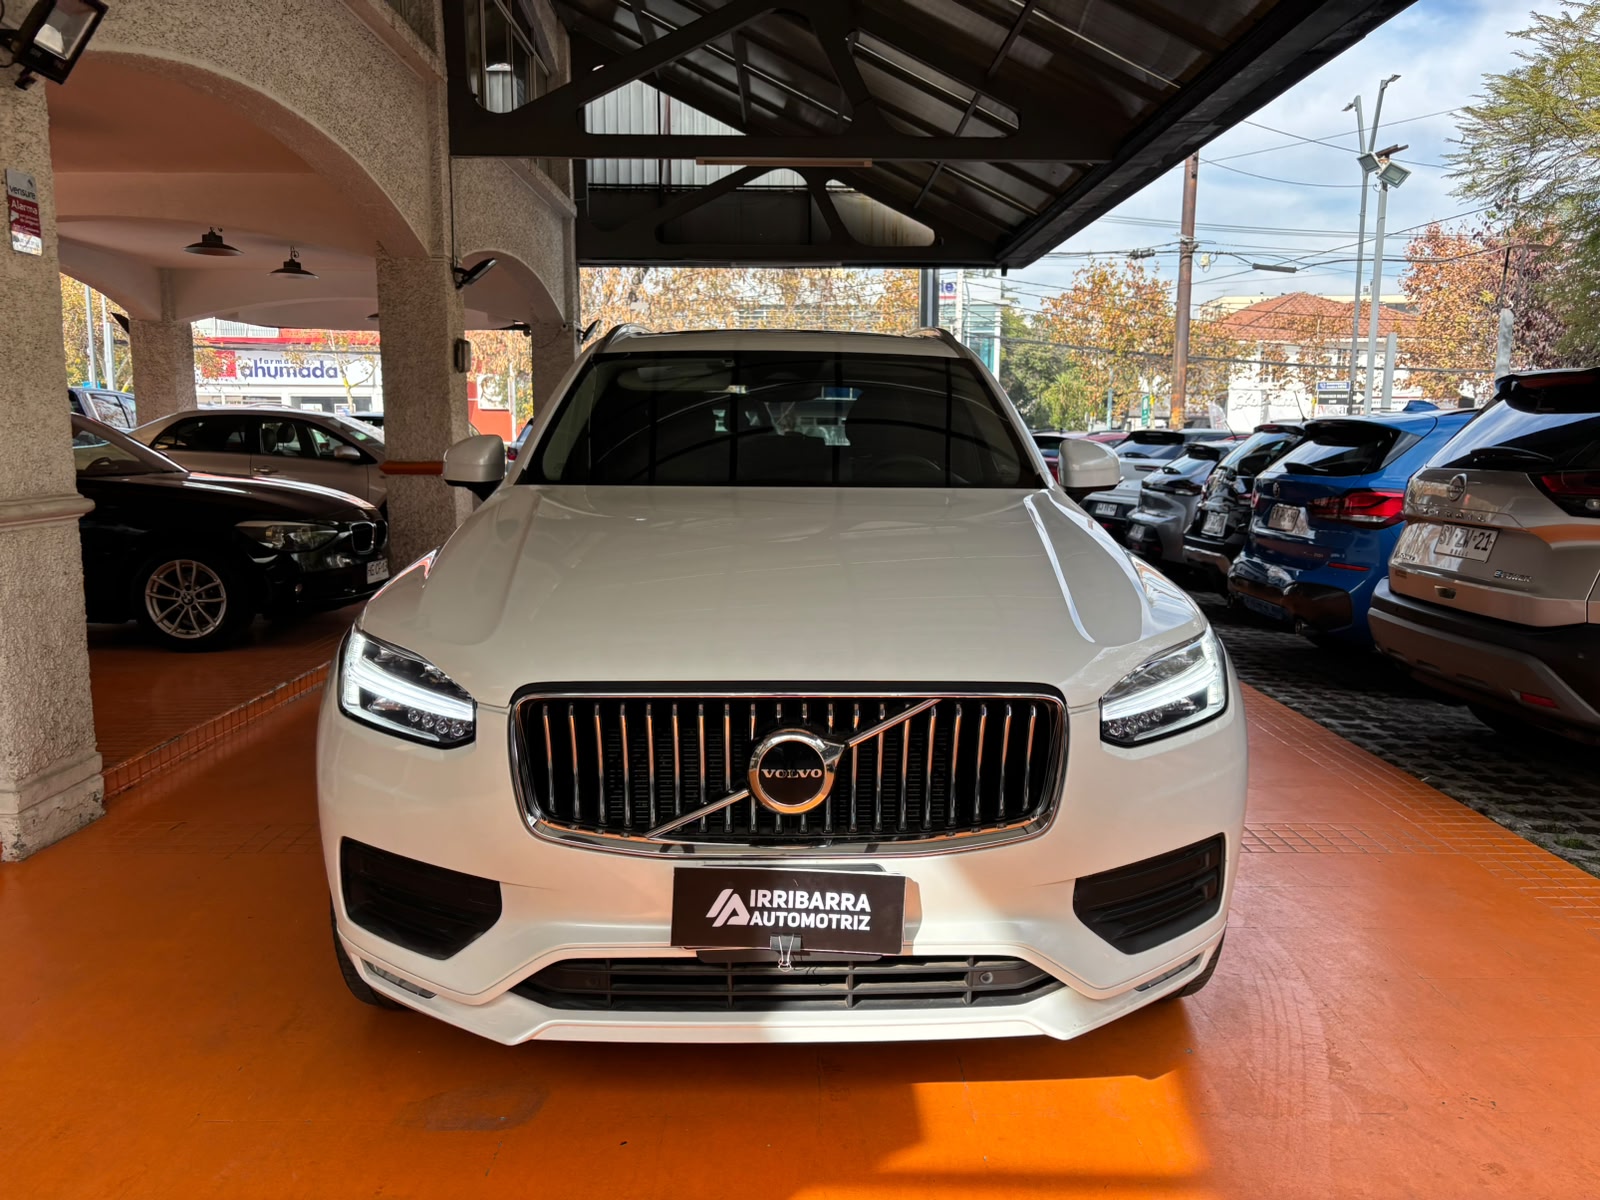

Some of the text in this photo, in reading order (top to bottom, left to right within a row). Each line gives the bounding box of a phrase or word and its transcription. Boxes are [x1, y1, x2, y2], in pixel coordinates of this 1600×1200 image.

[11, 200, 38, 214] Alarma
[241, 359, 338, 379] ahumada
[761, 768, 823, 779] VOLVO
[750, 889, 871, 912] IRRIBARRA
[750, 911, 871, 931] AUTOMOTRIZ
